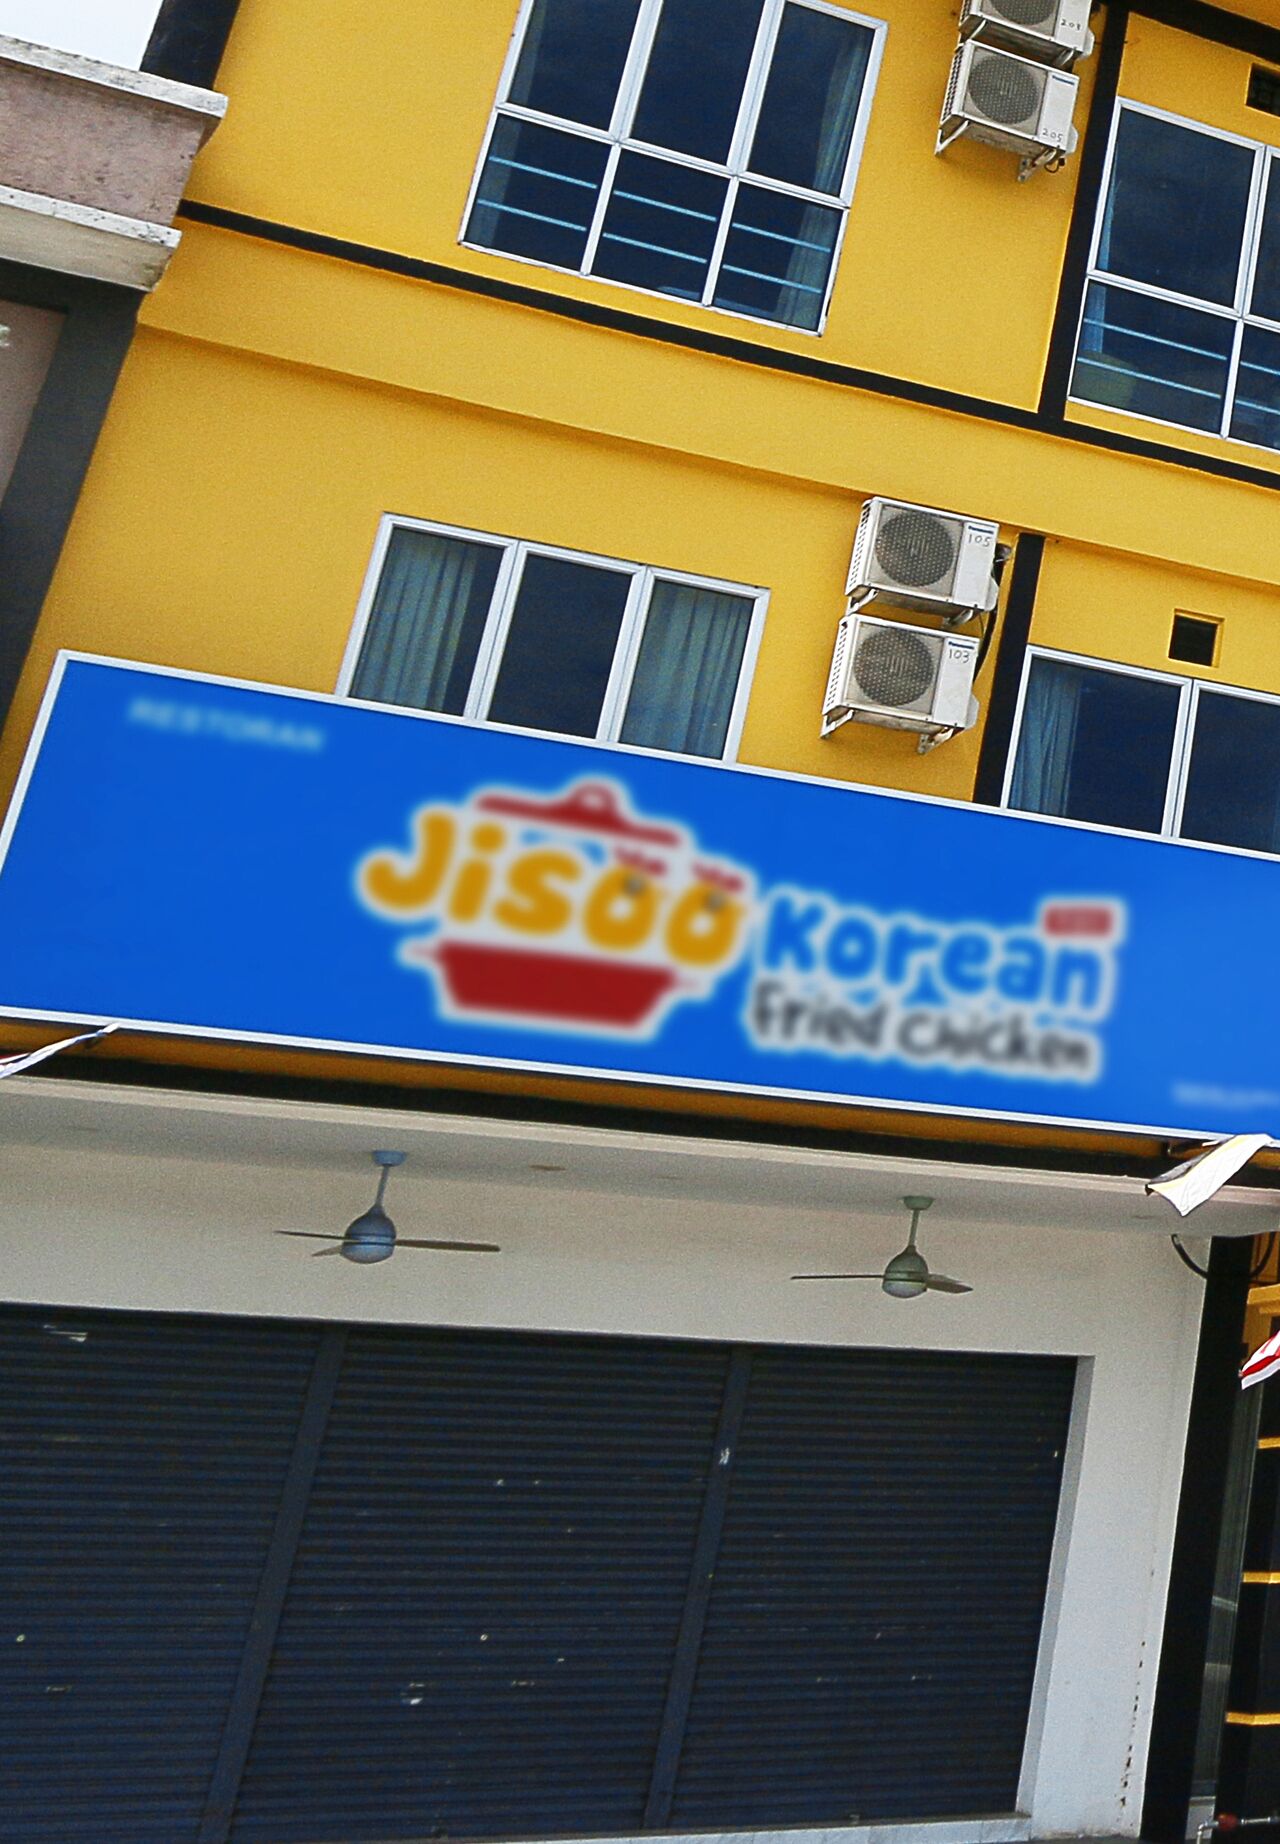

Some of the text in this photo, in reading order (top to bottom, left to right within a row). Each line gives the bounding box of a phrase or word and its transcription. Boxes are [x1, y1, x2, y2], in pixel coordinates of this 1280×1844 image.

[1042, 128, 1064, 142] 205
[968, 533, 992, 547] 105
[949, 649, 970, 664] 103
